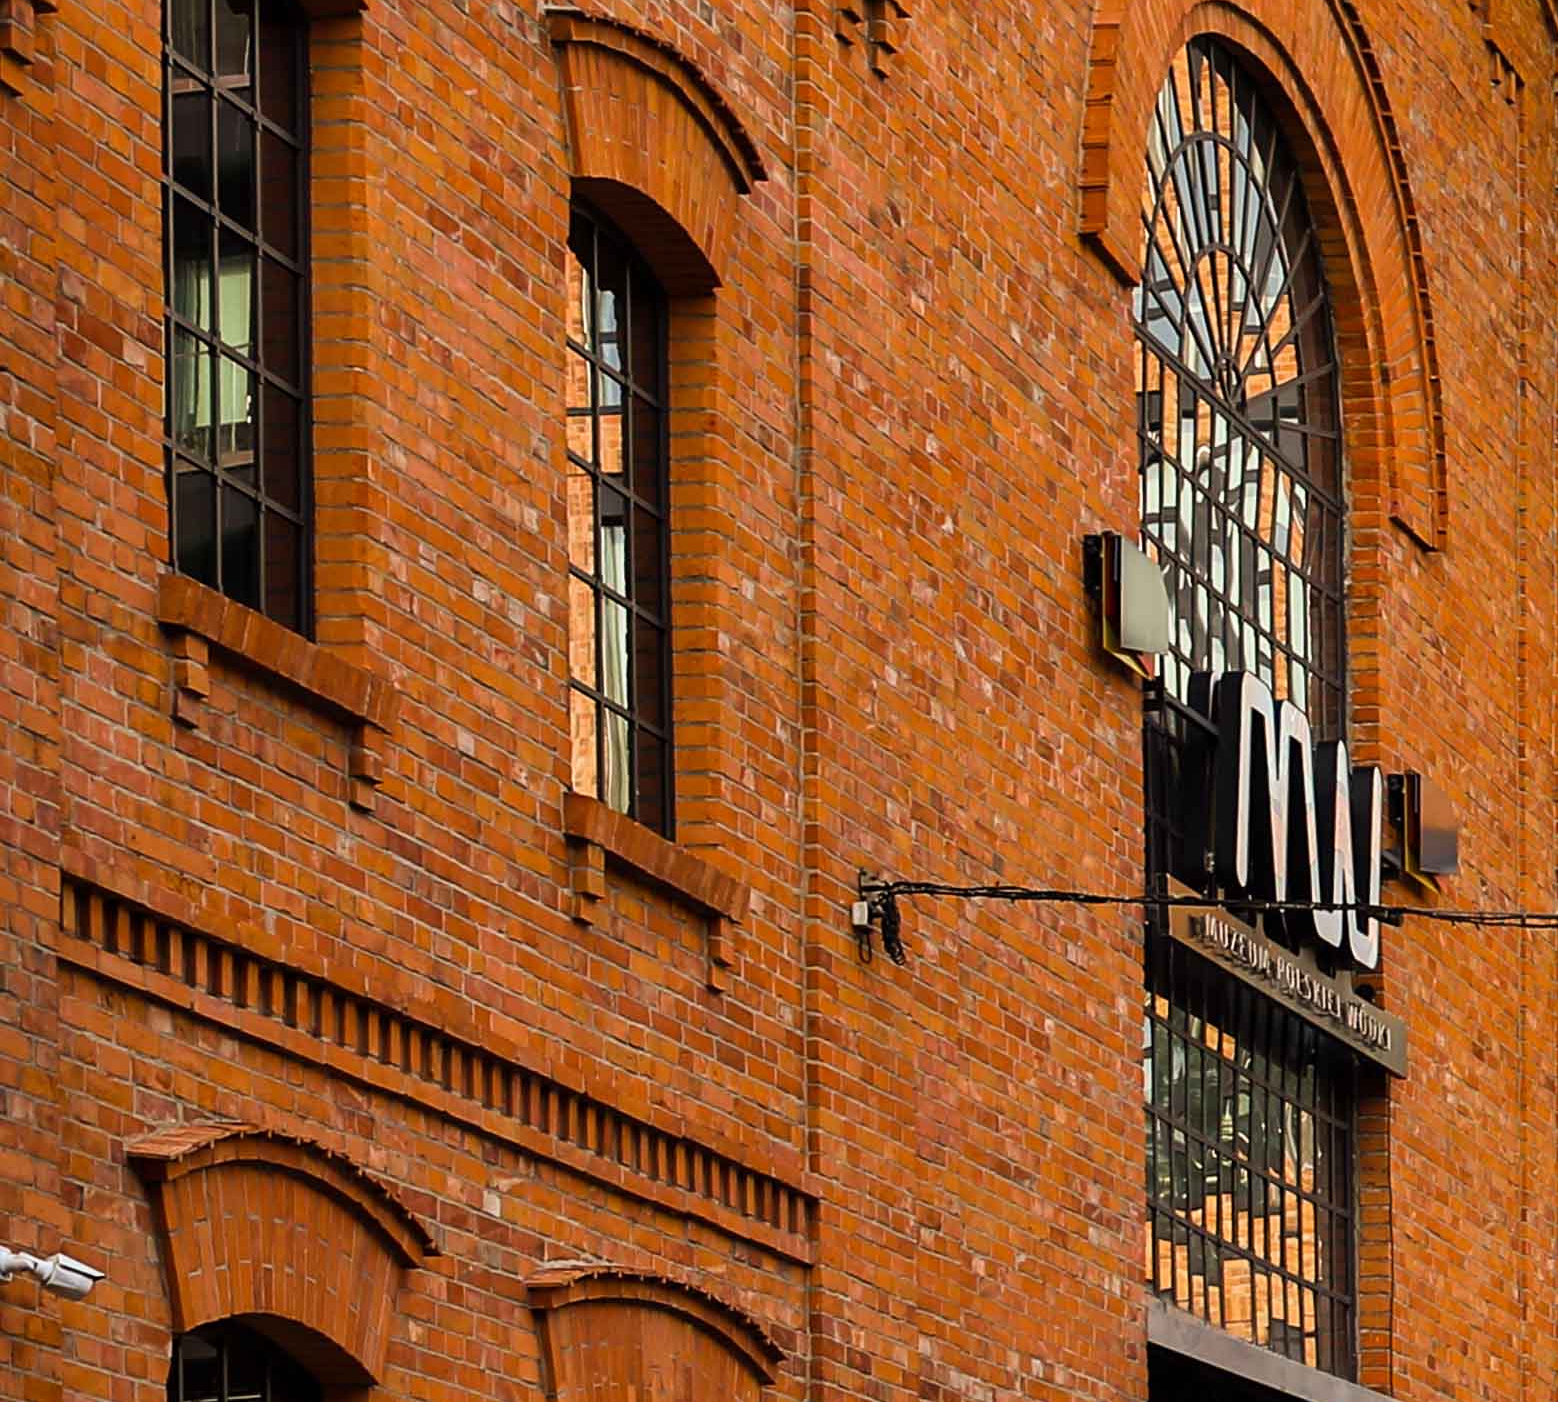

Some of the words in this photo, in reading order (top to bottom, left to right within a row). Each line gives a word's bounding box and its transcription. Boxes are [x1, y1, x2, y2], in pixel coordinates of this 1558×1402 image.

[1205, 912, 1272, 977] MUZEUM
[1276, 955, 1341, 1018] POLSKIEJ
[1346, 1001, 1392, 1051] WÓDKI
